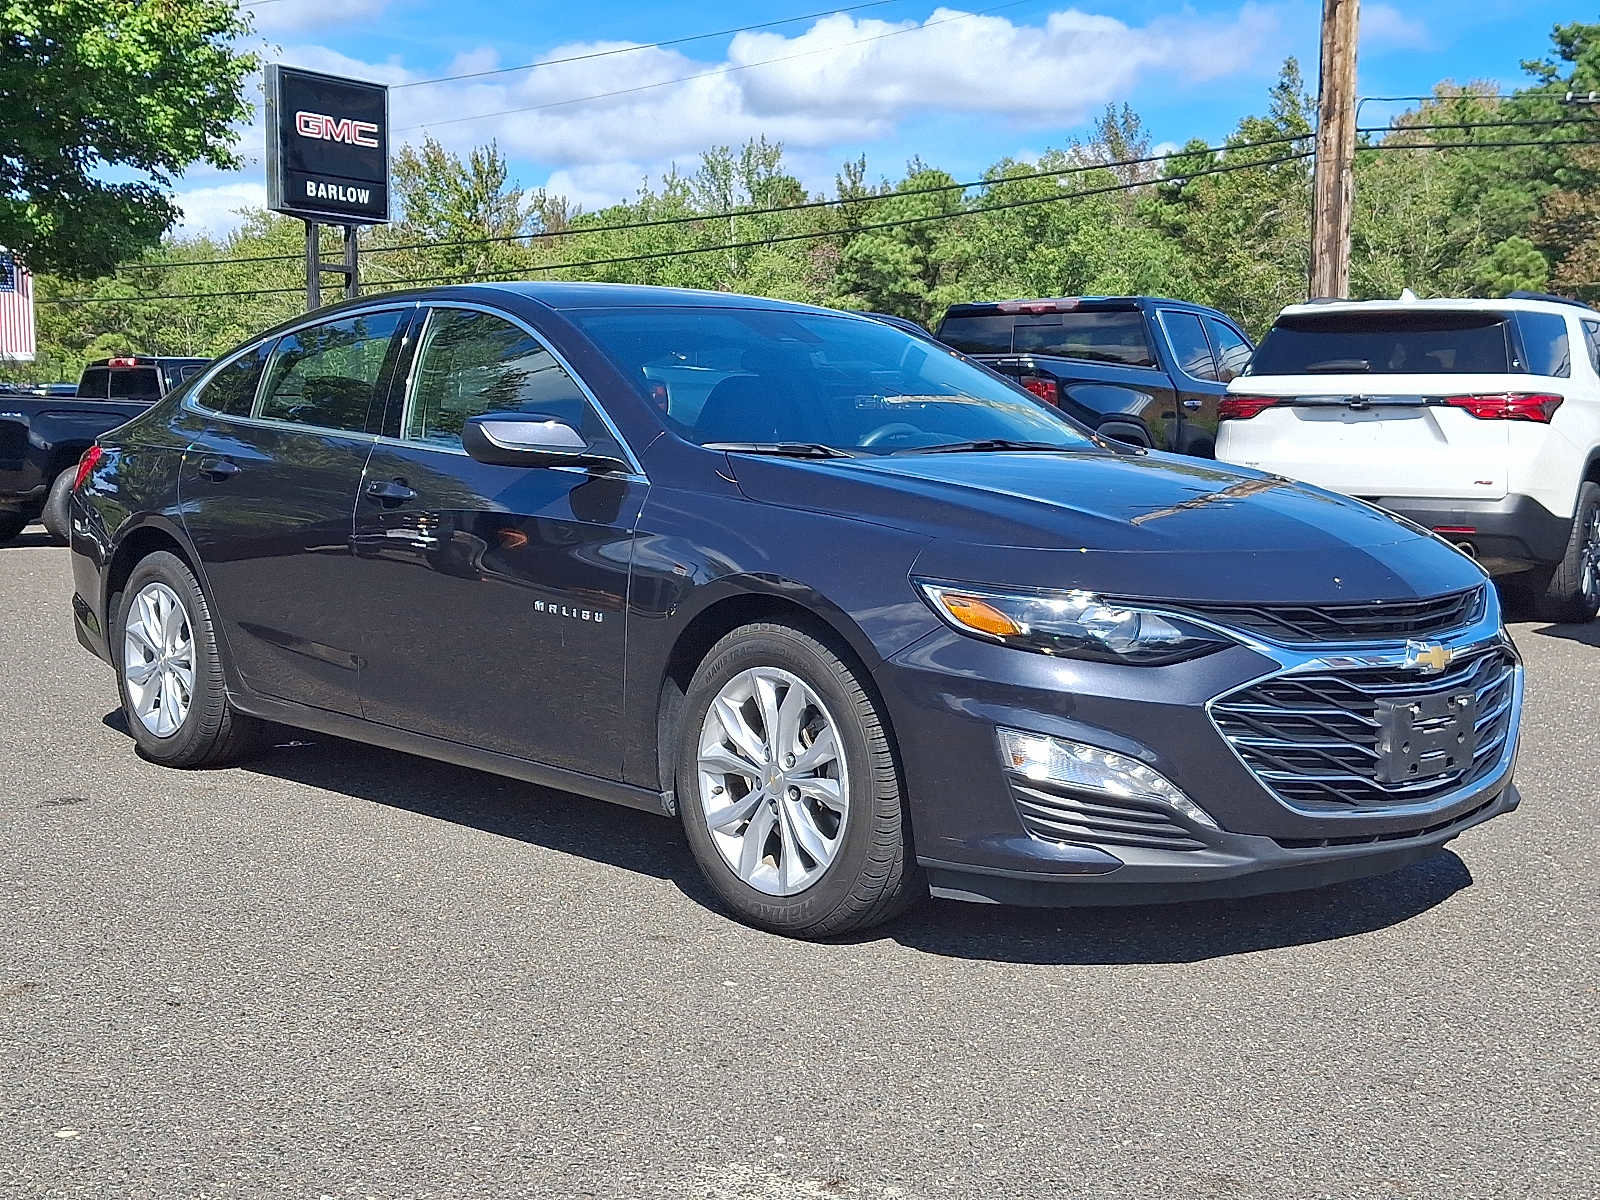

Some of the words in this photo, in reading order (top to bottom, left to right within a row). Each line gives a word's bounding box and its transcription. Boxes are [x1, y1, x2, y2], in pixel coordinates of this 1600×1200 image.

[295, 110, 379, 148] GMC
[306, 181, 370, 204] BARLOW
[533, 600, 604, 623] MALIBU
